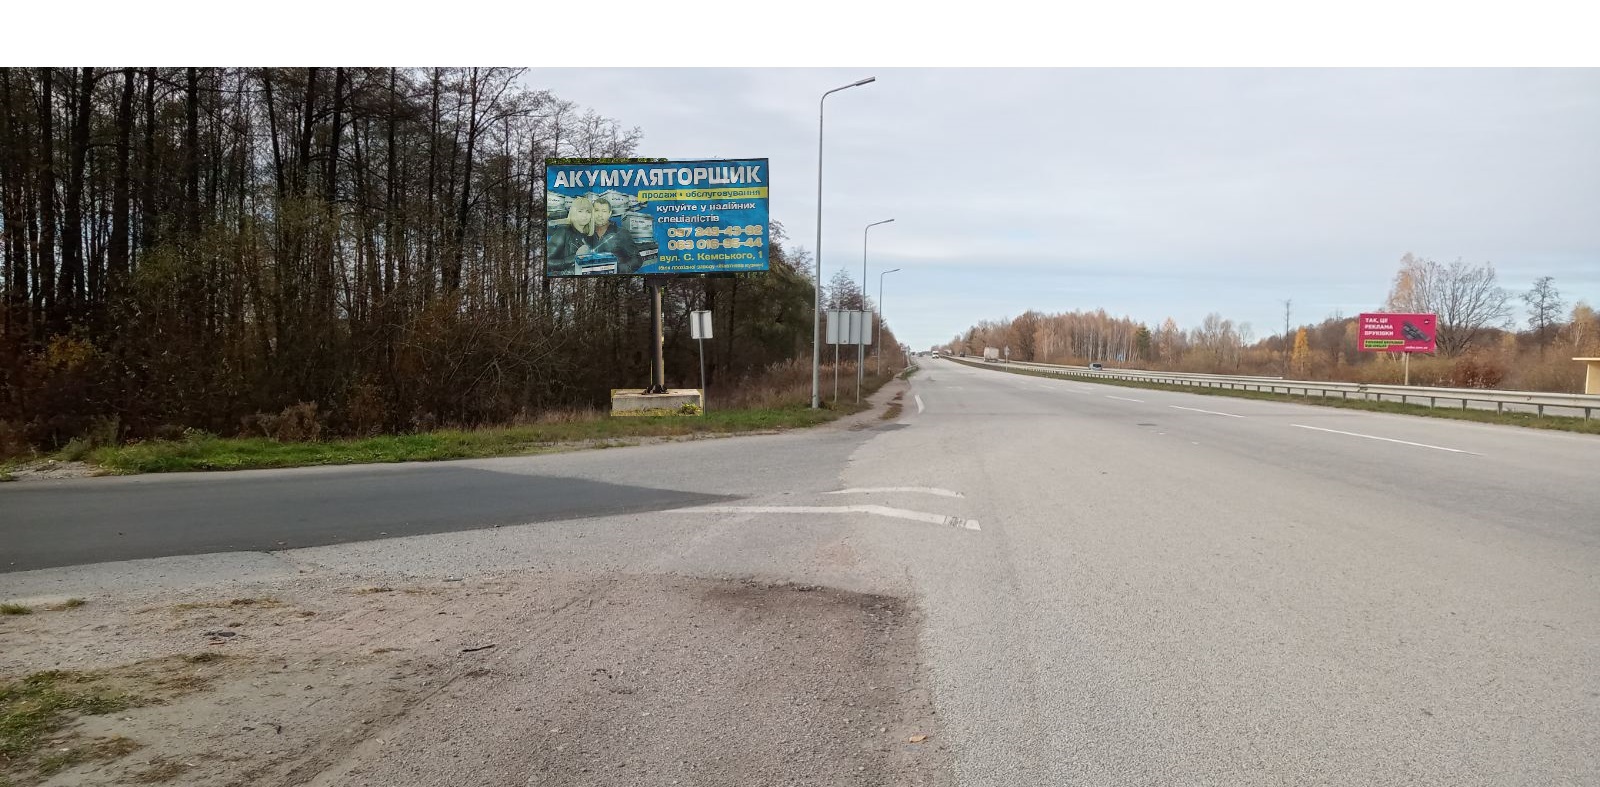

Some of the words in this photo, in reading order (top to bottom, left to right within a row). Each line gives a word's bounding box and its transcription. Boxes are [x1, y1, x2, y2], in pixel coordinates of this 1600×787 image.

[553, 165, 762, 188] АКУМУЛЯТОРЩИК
[642, 191, 677, 199] продаж
[685, 189, 761, 199] обслуговування
[656, 203, 697, 213] купуйте
[700, 203, 707, 212] у
[709, 201, 756, 211] надійних
[657, 214, 720, 223] спеціалістів
[659, 255, 681, 263] вул.
[683, 253, 694, 261] С.
[697, 251, 756, 261] Кемського,
[758, 250, 763, 259] 1
